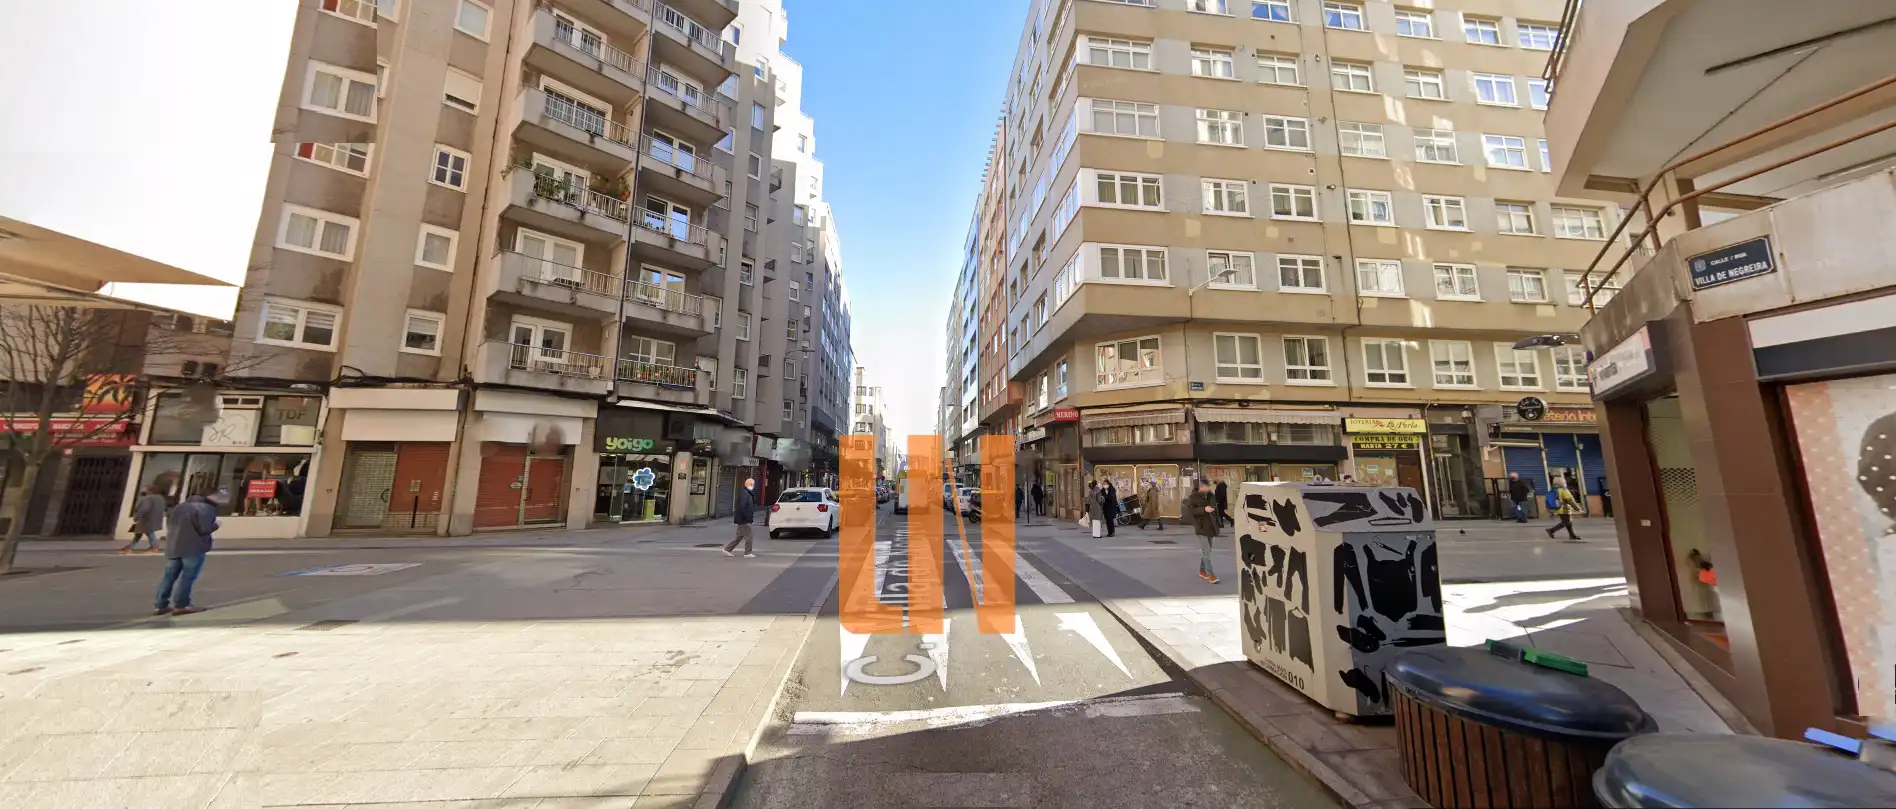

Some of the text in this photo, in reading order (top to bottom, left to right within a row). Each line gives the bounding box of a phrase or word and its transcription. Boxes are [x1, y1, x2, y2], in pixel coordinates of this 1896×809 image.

[1710, 256, 1728, 265] CALLE
[1695, 261, 1769, 285] VILLA DE NEGREIRA
[1056, 411, 1079, 419] MERINO
[606, 437, 654, 451] yoigo
[1288, 671, 1305, 690] 010
